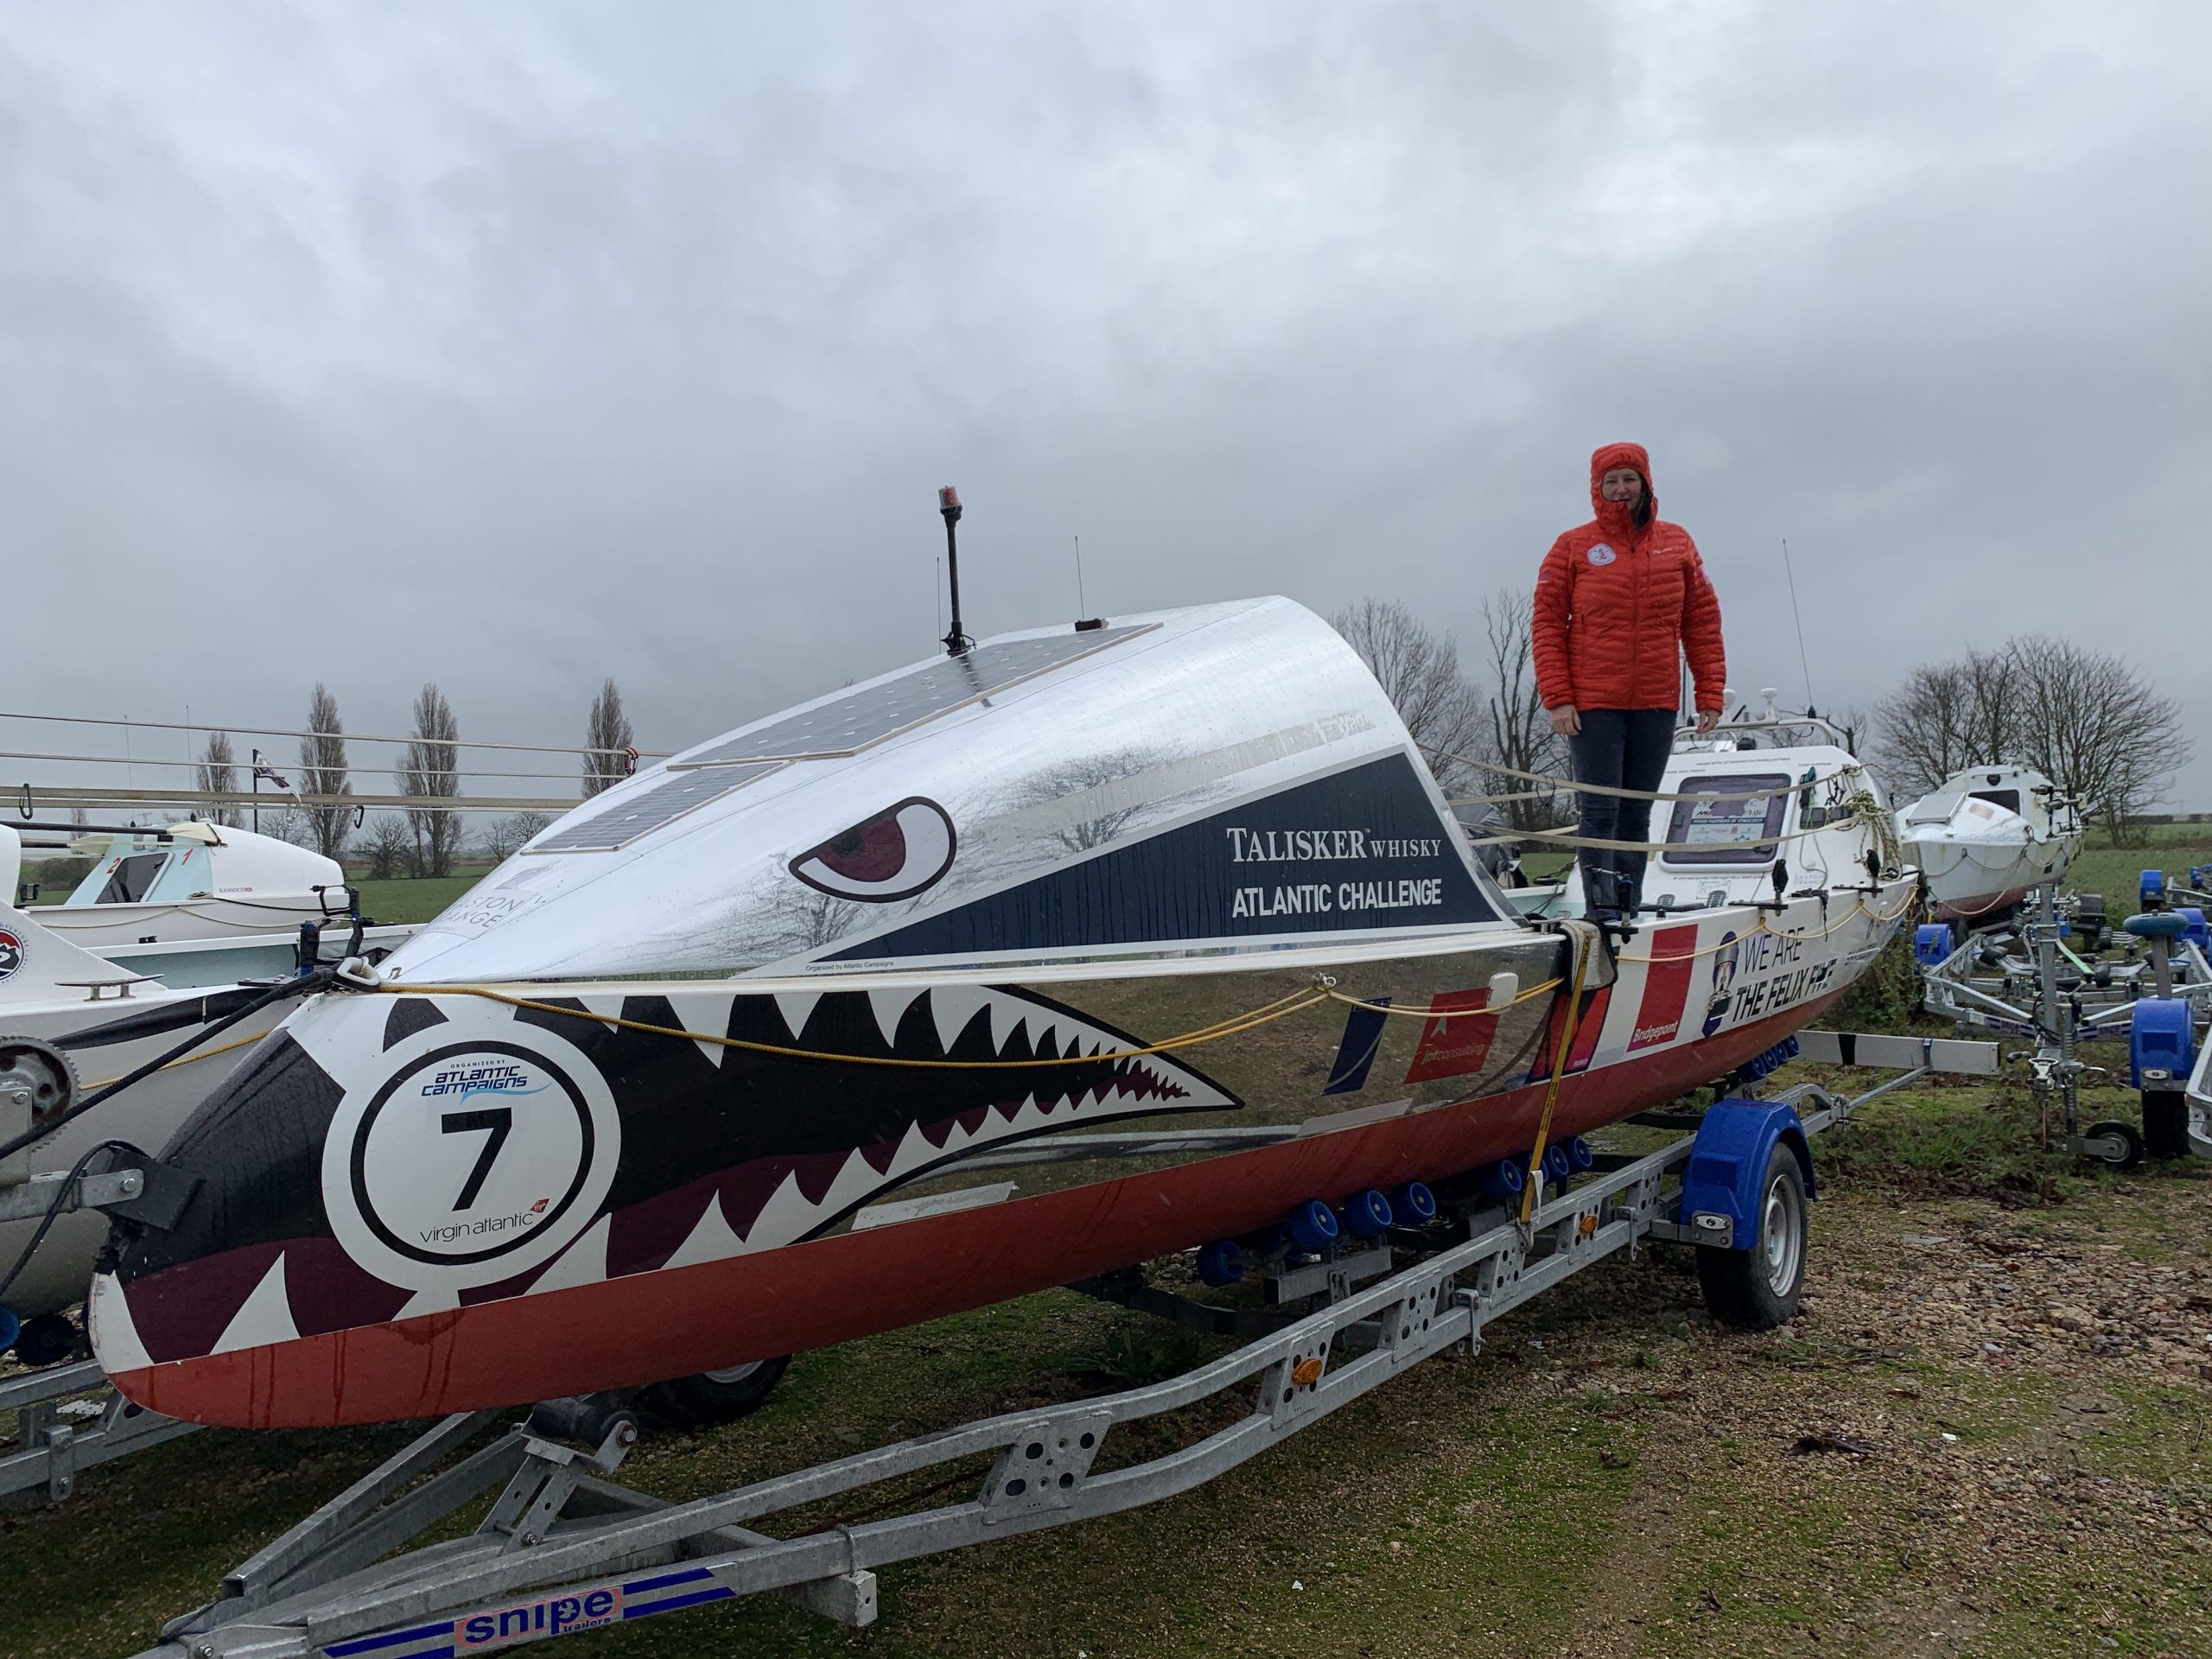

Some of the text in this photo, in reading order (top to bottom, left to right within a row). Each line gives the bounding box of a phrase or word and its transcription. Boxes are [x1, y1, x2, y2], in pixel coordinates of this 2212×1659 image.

[181, 848, 194, 866] 1
[1226, 827, 1368, 862] TALISKER
[1370, 838, 1442, 858] WHISKY
[105, 856, 122, 874] 2
[1232, 878, 1442, 918] ATLANTIC CHALLENGE
[1745, 933, 1772, 976] WE
[1772, 926, 1805, 968] ARE
[805, 964, 835, 973] Organized
[1732, 980, 1769, 1022] THE
[1764, 967, 1810, 1012] FELIX
[1632, 1020, 1679, 1043] Bridgepoint
[450, 1059, 495, 1069] ORGANIZED
[441, 1107, 512, 1212] 7
[420, 1212, 534, 1243] virgin atlantic
[465, 1591, 613, 1643] snipe
[563, 1616, 612, 1632] trailers
